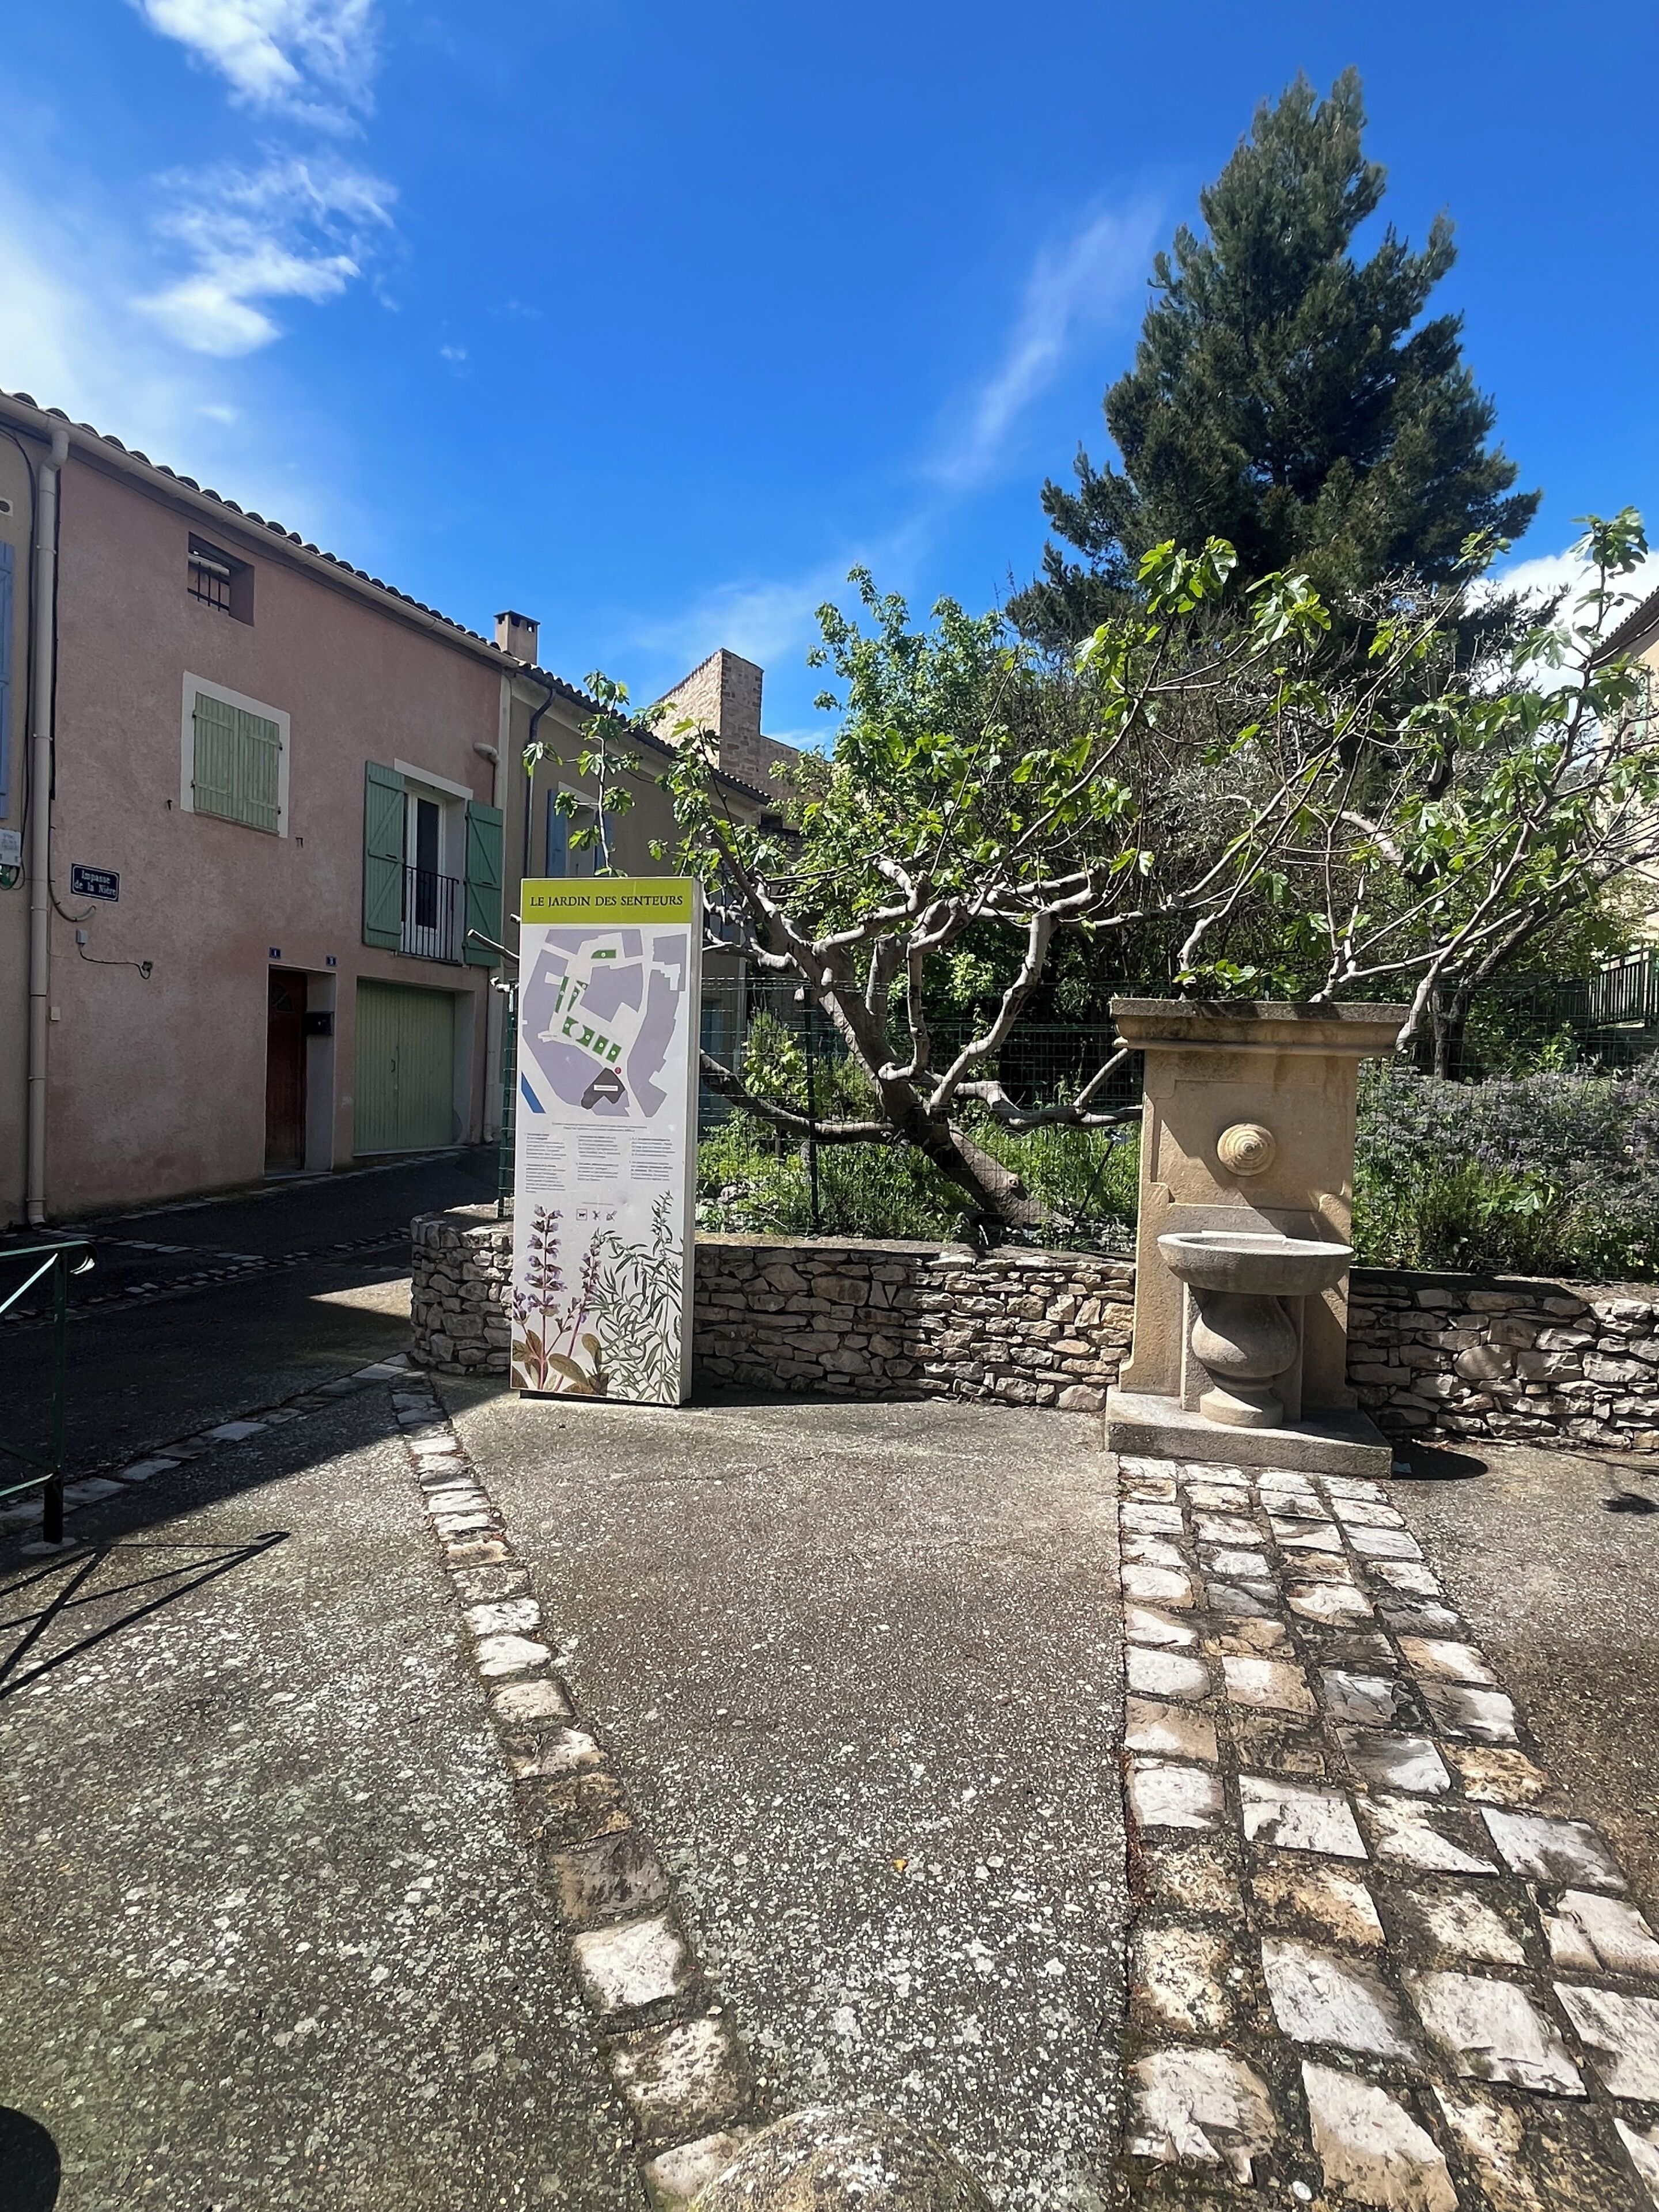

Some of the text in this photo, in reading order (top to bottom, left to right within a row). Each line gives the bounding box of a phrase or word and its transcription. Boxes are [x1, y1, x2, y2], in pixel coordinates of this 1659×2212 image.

[75, 880, 83, 889] de
[87, 881, 94, 892] la
[530, 895, 683, 907] LE JARDIN DES SENTEURS
